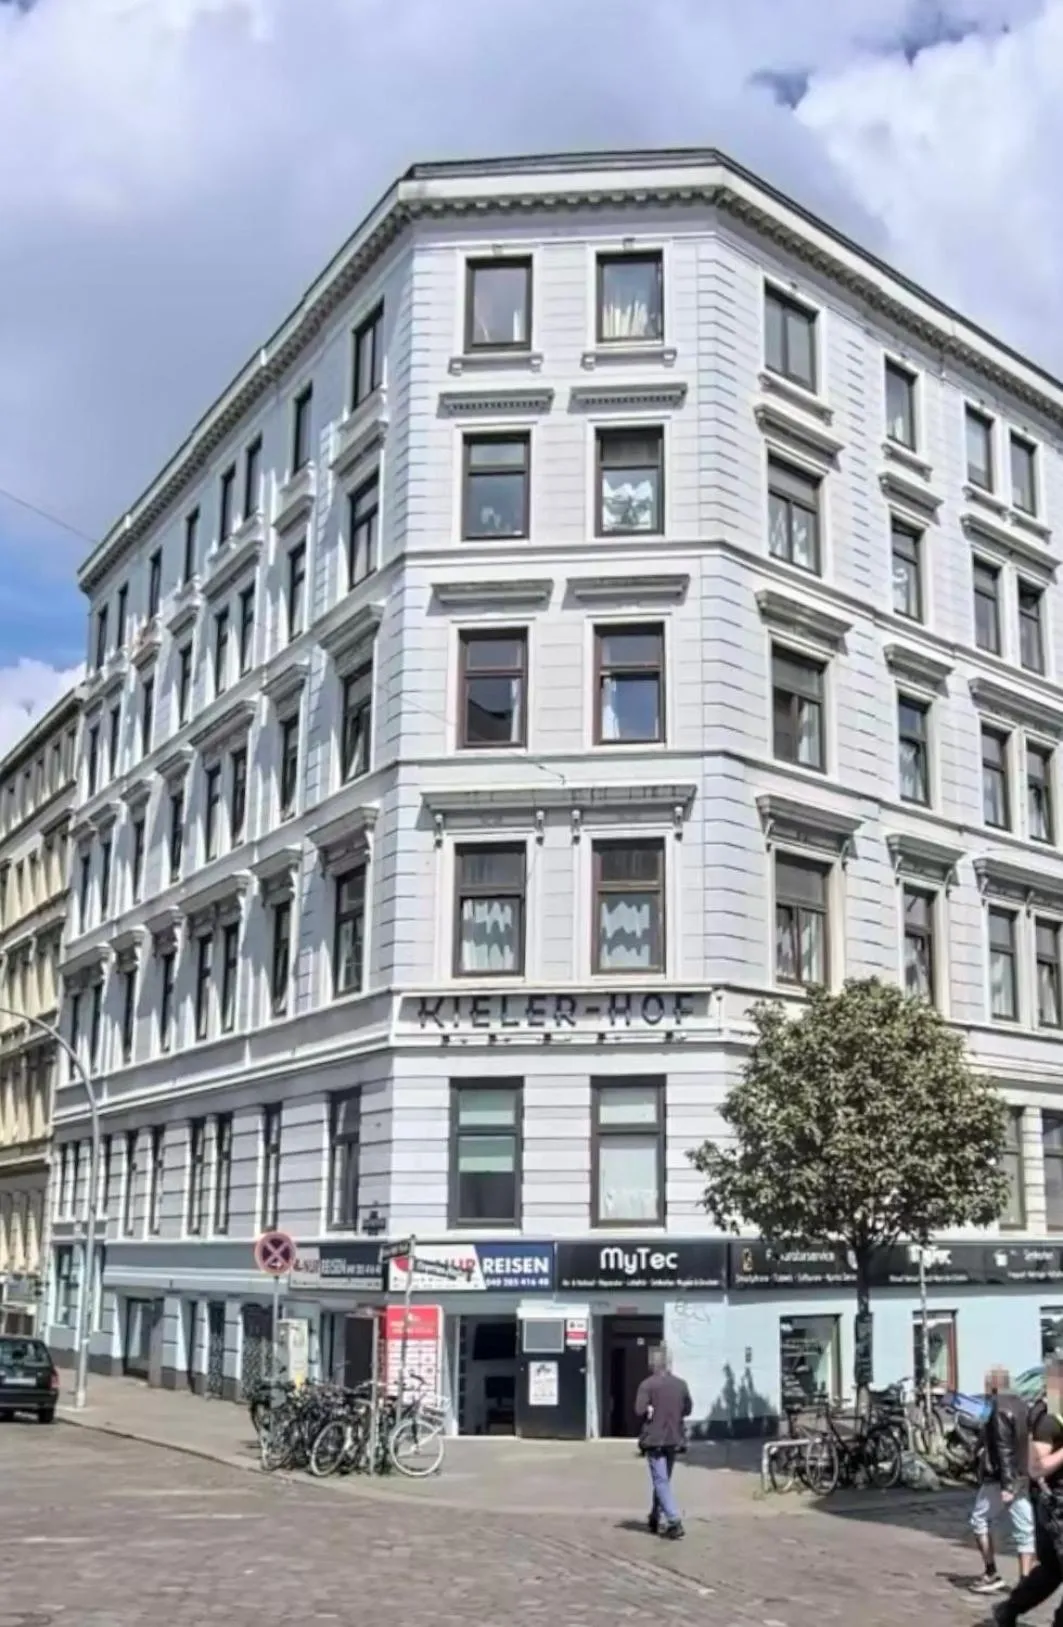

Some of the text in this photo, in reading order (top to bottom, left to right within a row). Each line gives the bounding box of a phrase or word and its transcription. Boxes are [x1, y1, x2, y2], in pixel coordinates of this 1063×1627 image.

[417, 992, 694, 1029] KIELER-HOF
[482, 1256, 549, 1274] REISEN
[600, 1247, 678, 1274] MyTec
